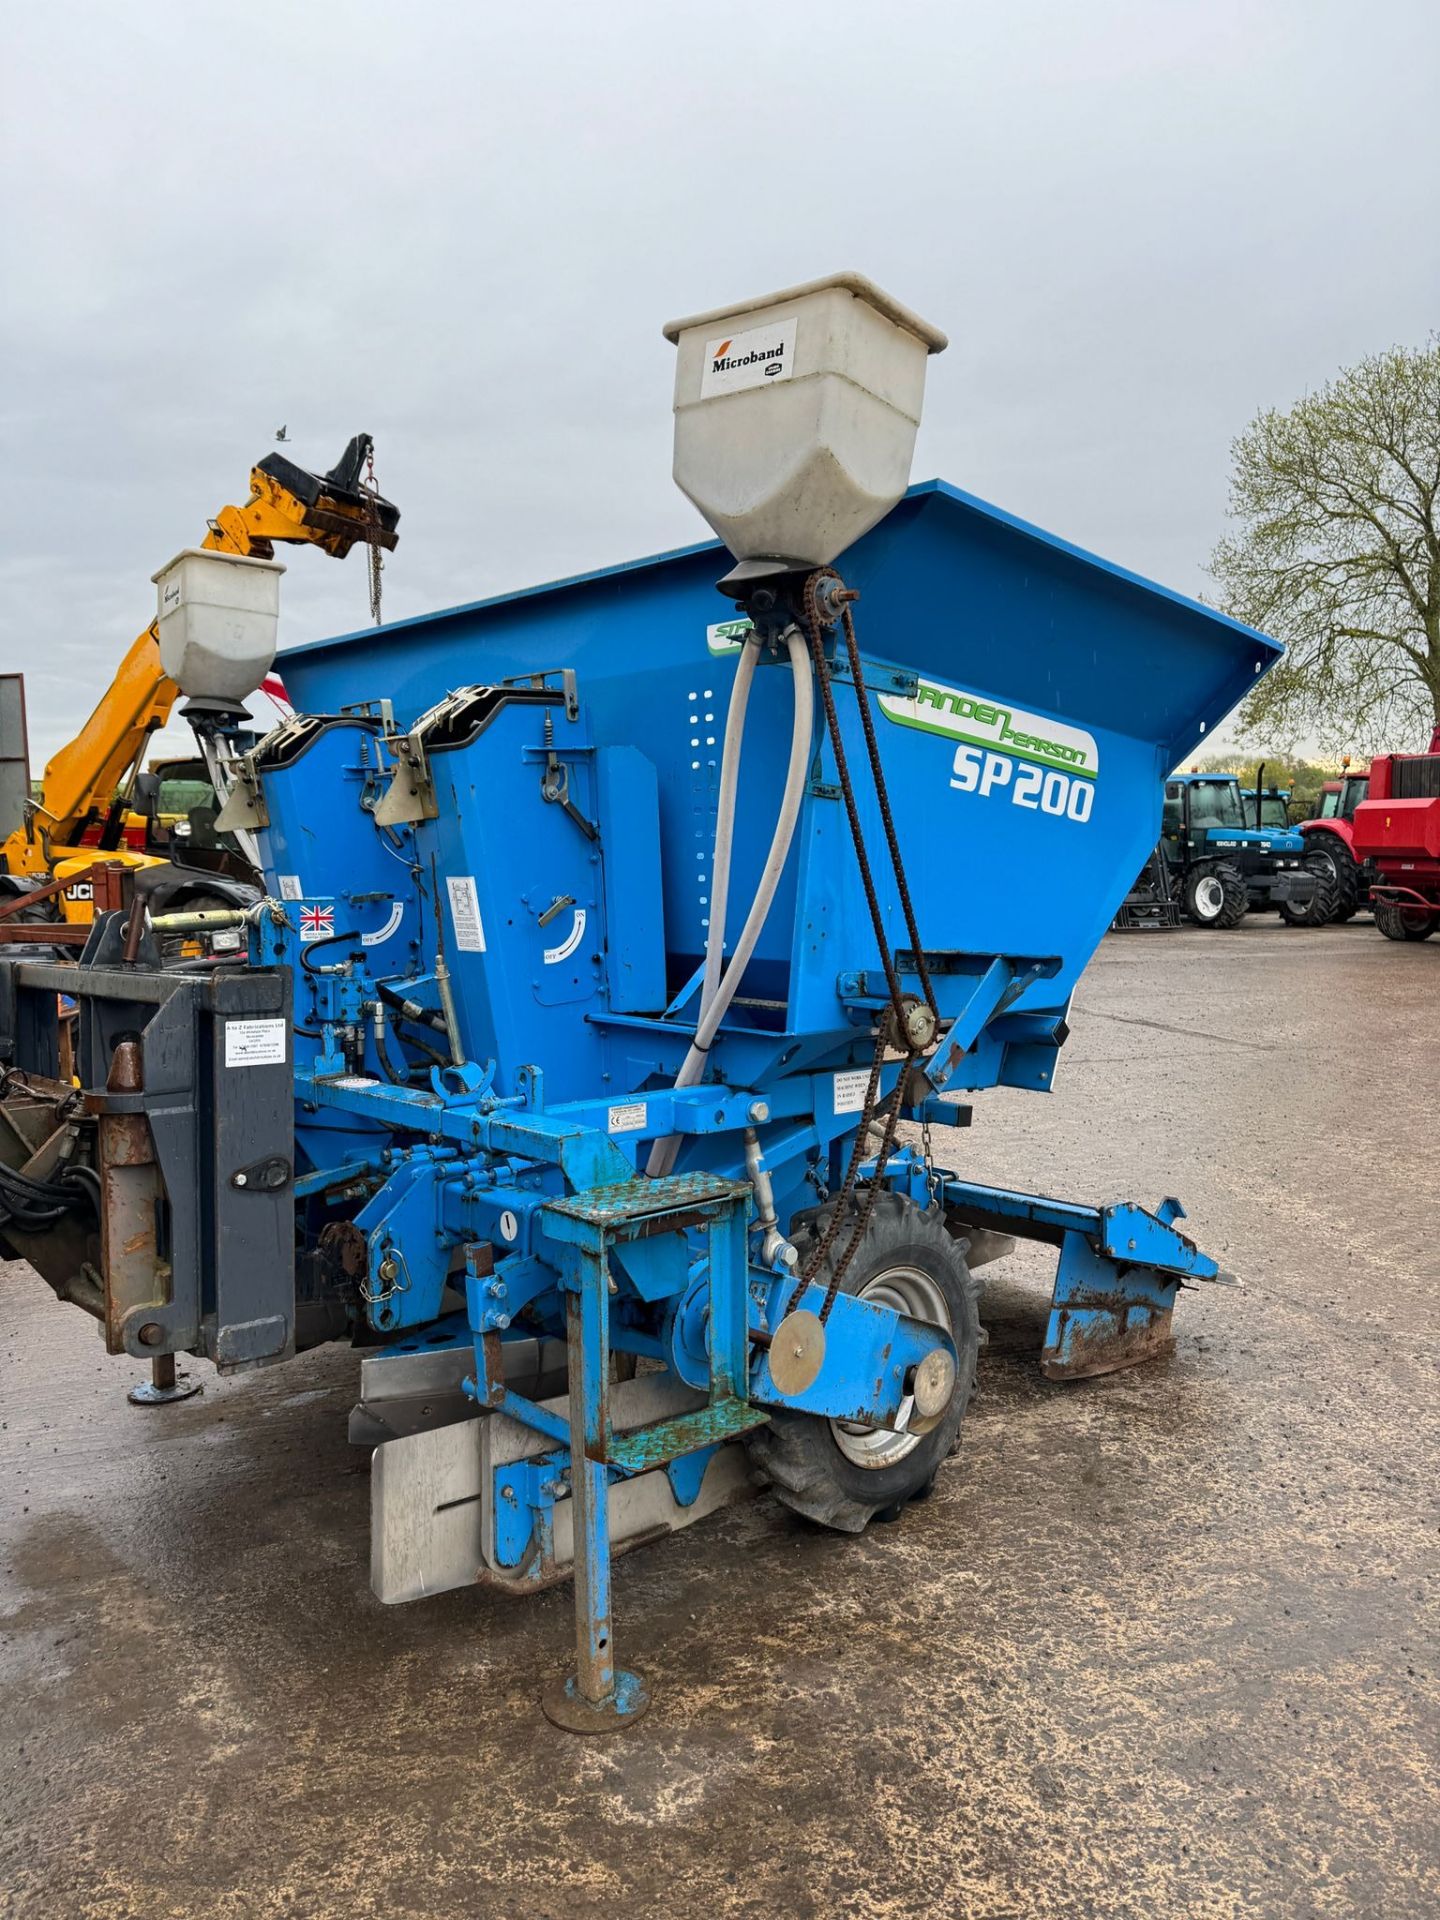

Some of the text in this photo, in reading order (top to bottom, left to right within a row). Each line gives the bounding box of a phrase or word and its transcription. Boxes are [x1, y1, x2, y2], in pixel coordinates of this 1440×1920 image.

[712, 342, 785, 373] Microband
[916, 684, 1011, 732] ANDEN
[999, 729, 1087, 765] PEARSON
